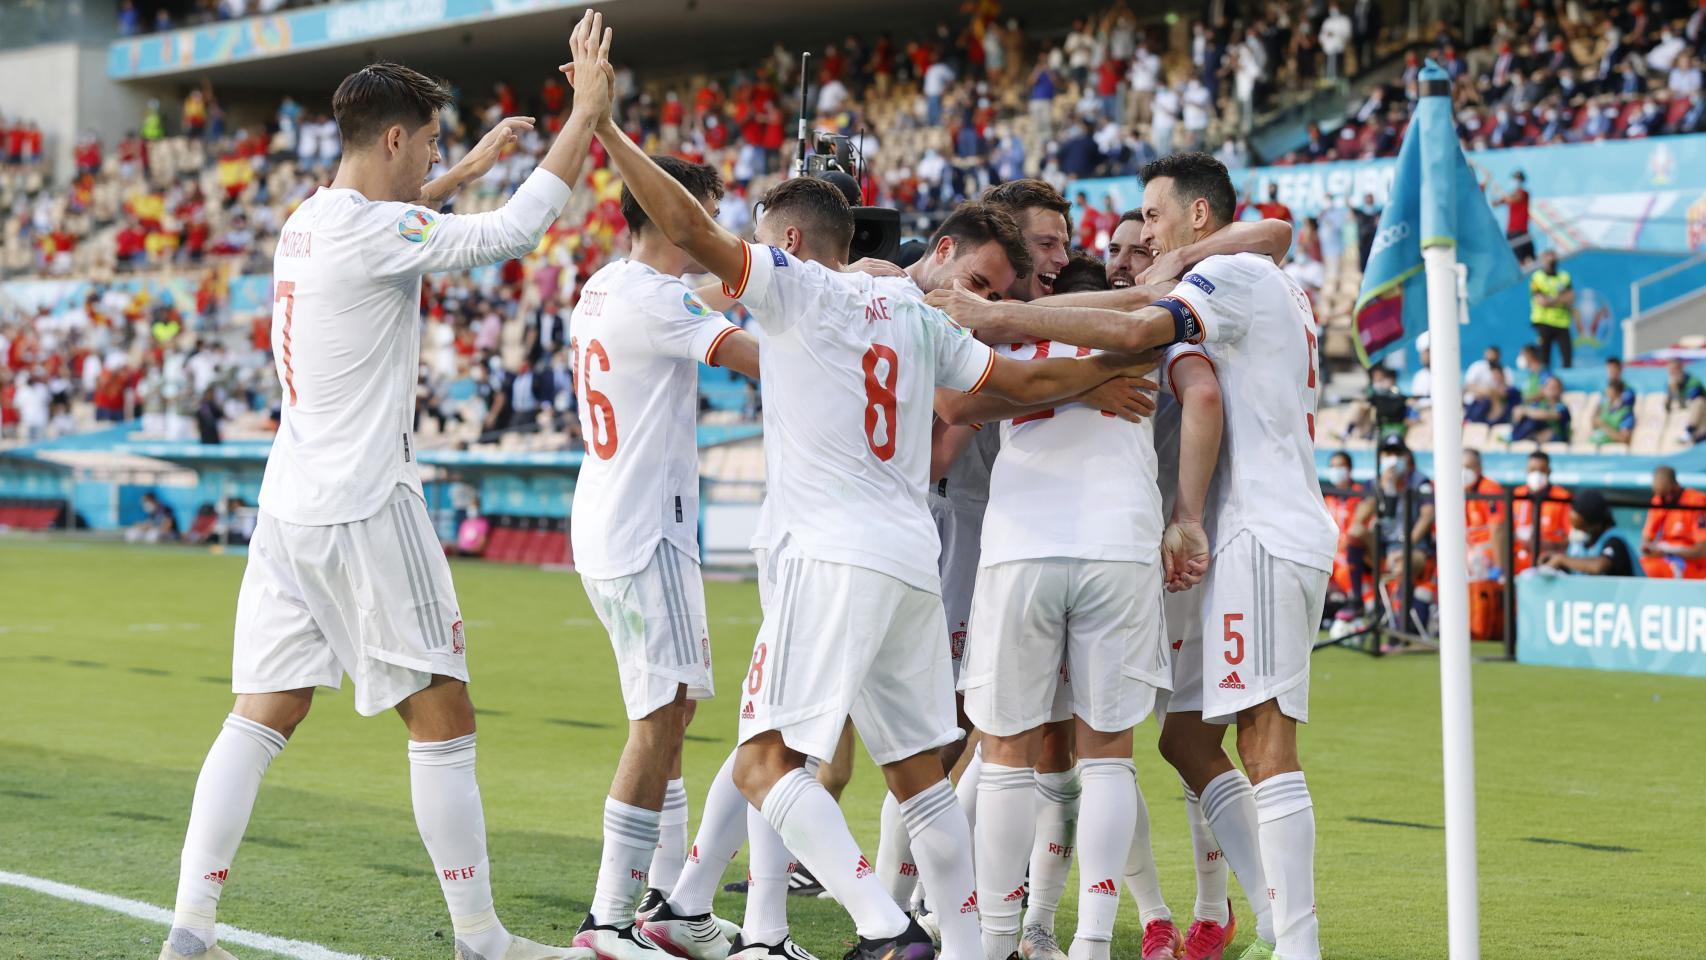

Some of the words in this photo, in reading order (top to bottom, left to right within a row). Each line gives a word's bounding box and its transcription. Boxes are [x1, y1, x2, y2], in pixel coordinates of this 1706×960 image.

[280, 230, 312, 258] MORATA
[1186, 275, 1213, 294] SPECT
[275, 280, 299, 407] 7
[862, 343, 899, 463] 8
[1545, 599, 1638, 650] UEFA
[1223, 613, 1245, 666] 5
[748, 642, 767, 696] 8
[1218, 682, 1246, 690] adidas
[1207, 849, 1223, 861] RF
[443, 865, 476, 880] RFEF
[900, 862, 918, 876] RFE
[1088, 888, 1118, 897] adidas
[960, 904, 978, 914] adid
